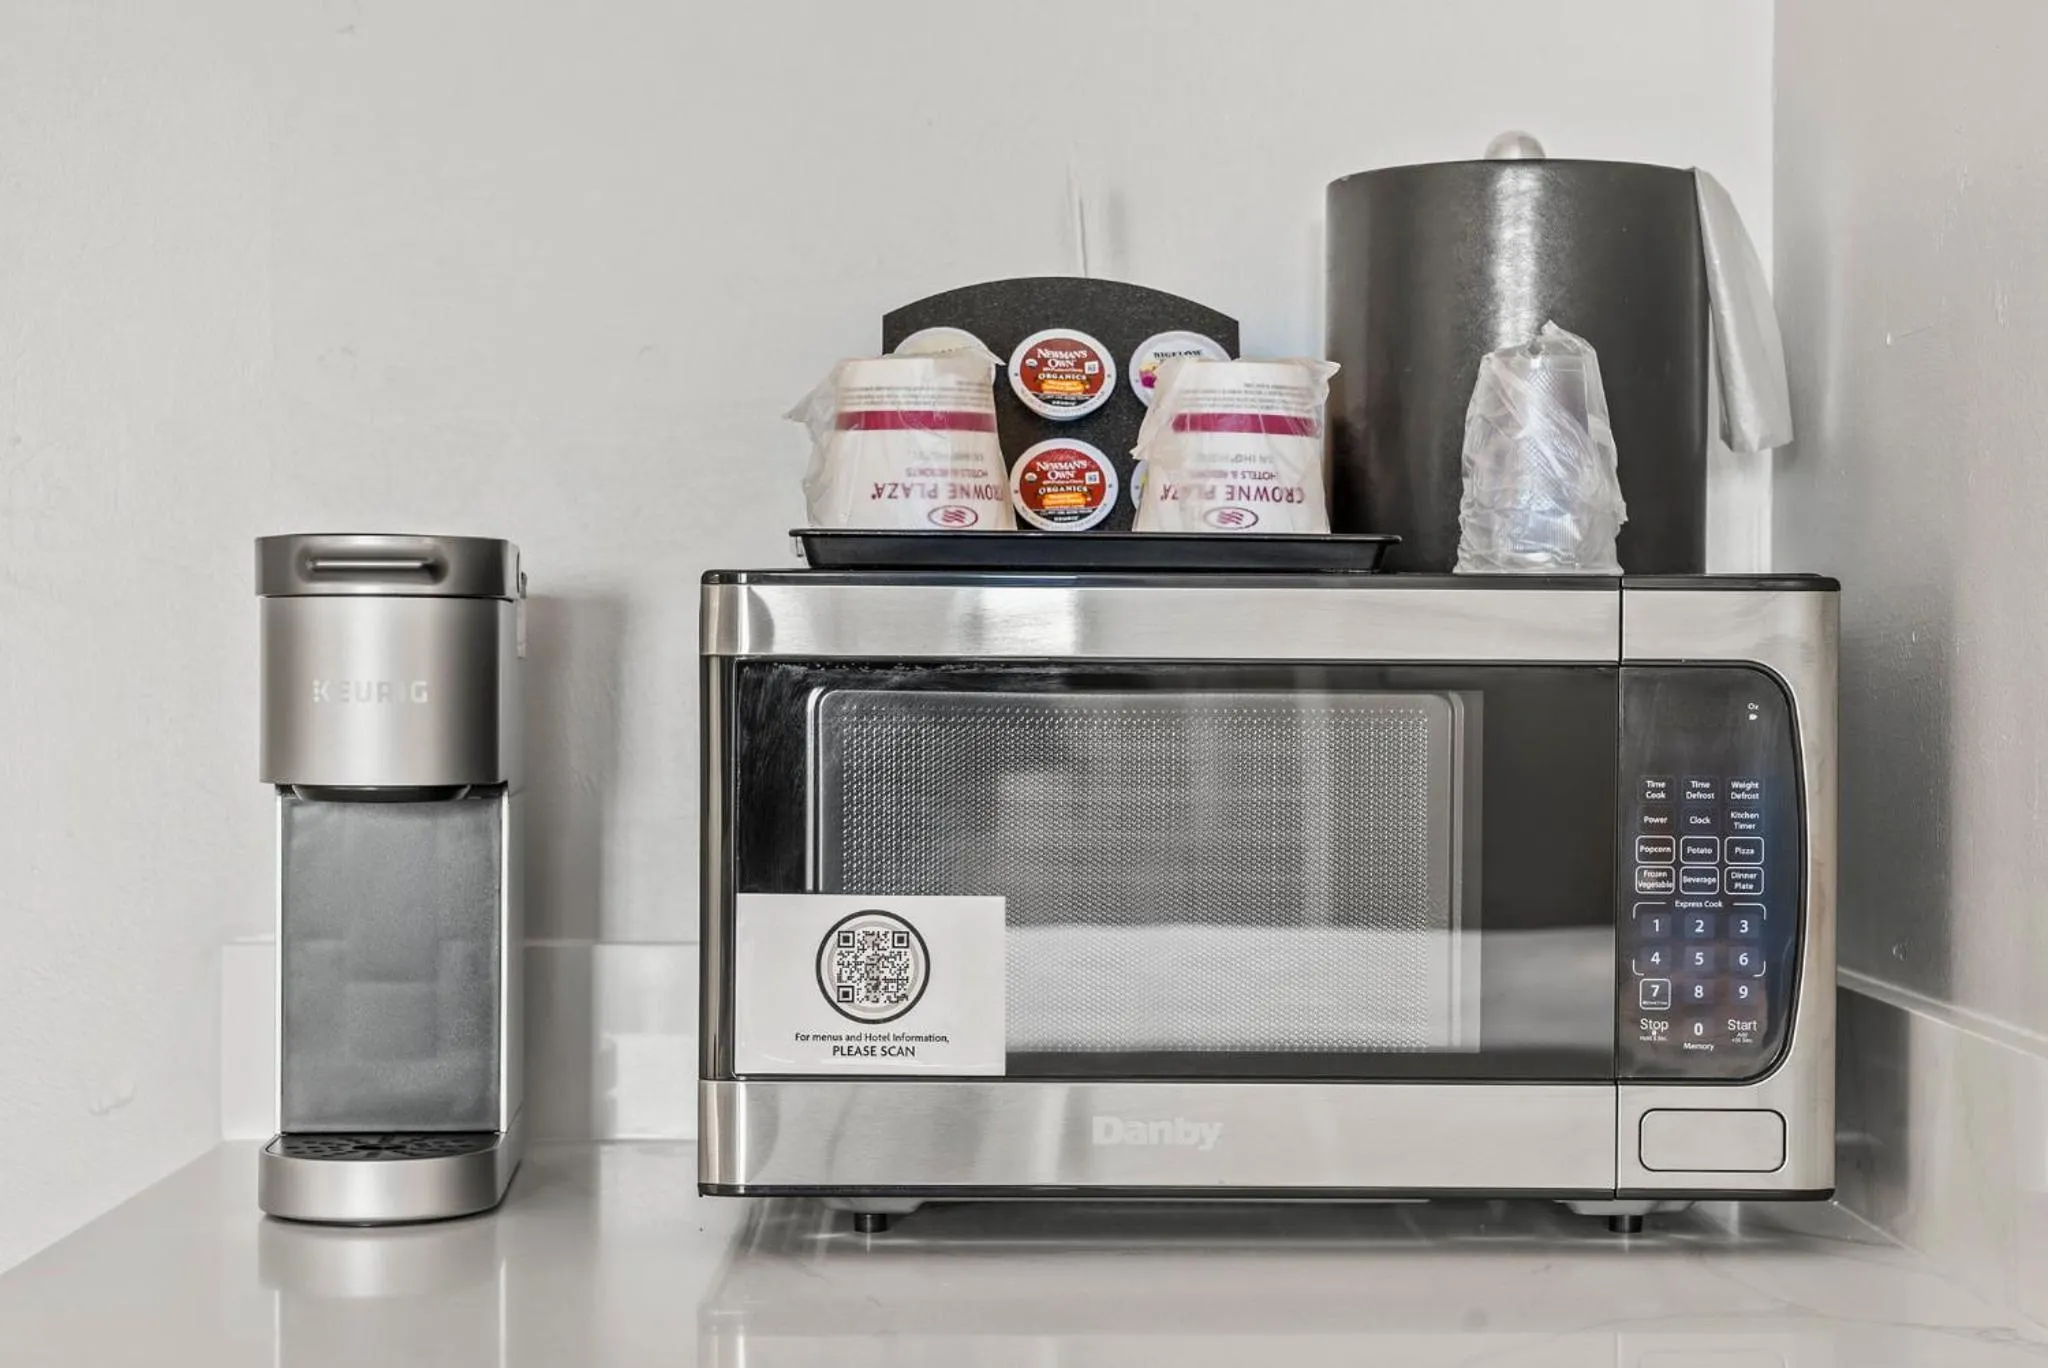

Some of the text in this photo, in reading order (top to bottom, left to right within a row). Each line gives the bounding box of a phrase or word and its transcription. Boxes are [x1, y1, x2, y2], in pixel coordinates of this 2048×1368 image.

[1038, 373, 1087, 381] ORGANICS
[874, 482, 938, 500] PLAZA
[1038, 486, 1088, 495] ORGANICS
[1226, 484, 1305, 504] CROWNE
[313, 679, 428, 703] KEURIG
[1646, 780, 1666, 789] Time
[1690, 780, 1711, 789] Time
[1731, 781, 1759, 791] Weight
[1645, 791, 1667, 799] Cook
[1686, 791, 1715, 800] Defrost
[1730, 791, 1759, 800] Defrost
[1643, 816, 1668, 824] Power
[1689, 816, 1711, 824] Clock
[1730, 811, 1759, 820] Kitchen
[1734, 822, 1756, 830] Timer
[1639, 845, 1672, 855] Popcorn
[1687, 846, 1713, 855] Potato
[1734, 846, 1755, 855] Pizza
[1731, 871, 1758, 880] Dinner
[1734, 882, 1754, 890] Plate
[1675, 900, 1723, 910] Express Cook
[1652, 919, 1660, 932] 1
[1695, 919, 1704, 933] 2
[1739, 919, 1749, 933] 3
[1650, 952, 1661, 964] 4
[1695, 952, 1704, 966] 5
[1738, 952, 1749, 966] 6
[1650, 985, 1660, 997] 7
[1694, 985, 1704, 998] 8
[1738, 985, 1749, 999] 9
[1640, 1018, 1669, 1031] Stop
[1693, 1023, 1703, 1036] 0
[1727, 1019, 1757, 1031] Start
[795, 1032, 950, 1044] For menus and Hotel Information,
[832, 1045, 916, 1057] PLEASE SCAN
[1683, 1042, 1715, 1051] Memory
[1092, 1115, 1224, 1151] Danby
